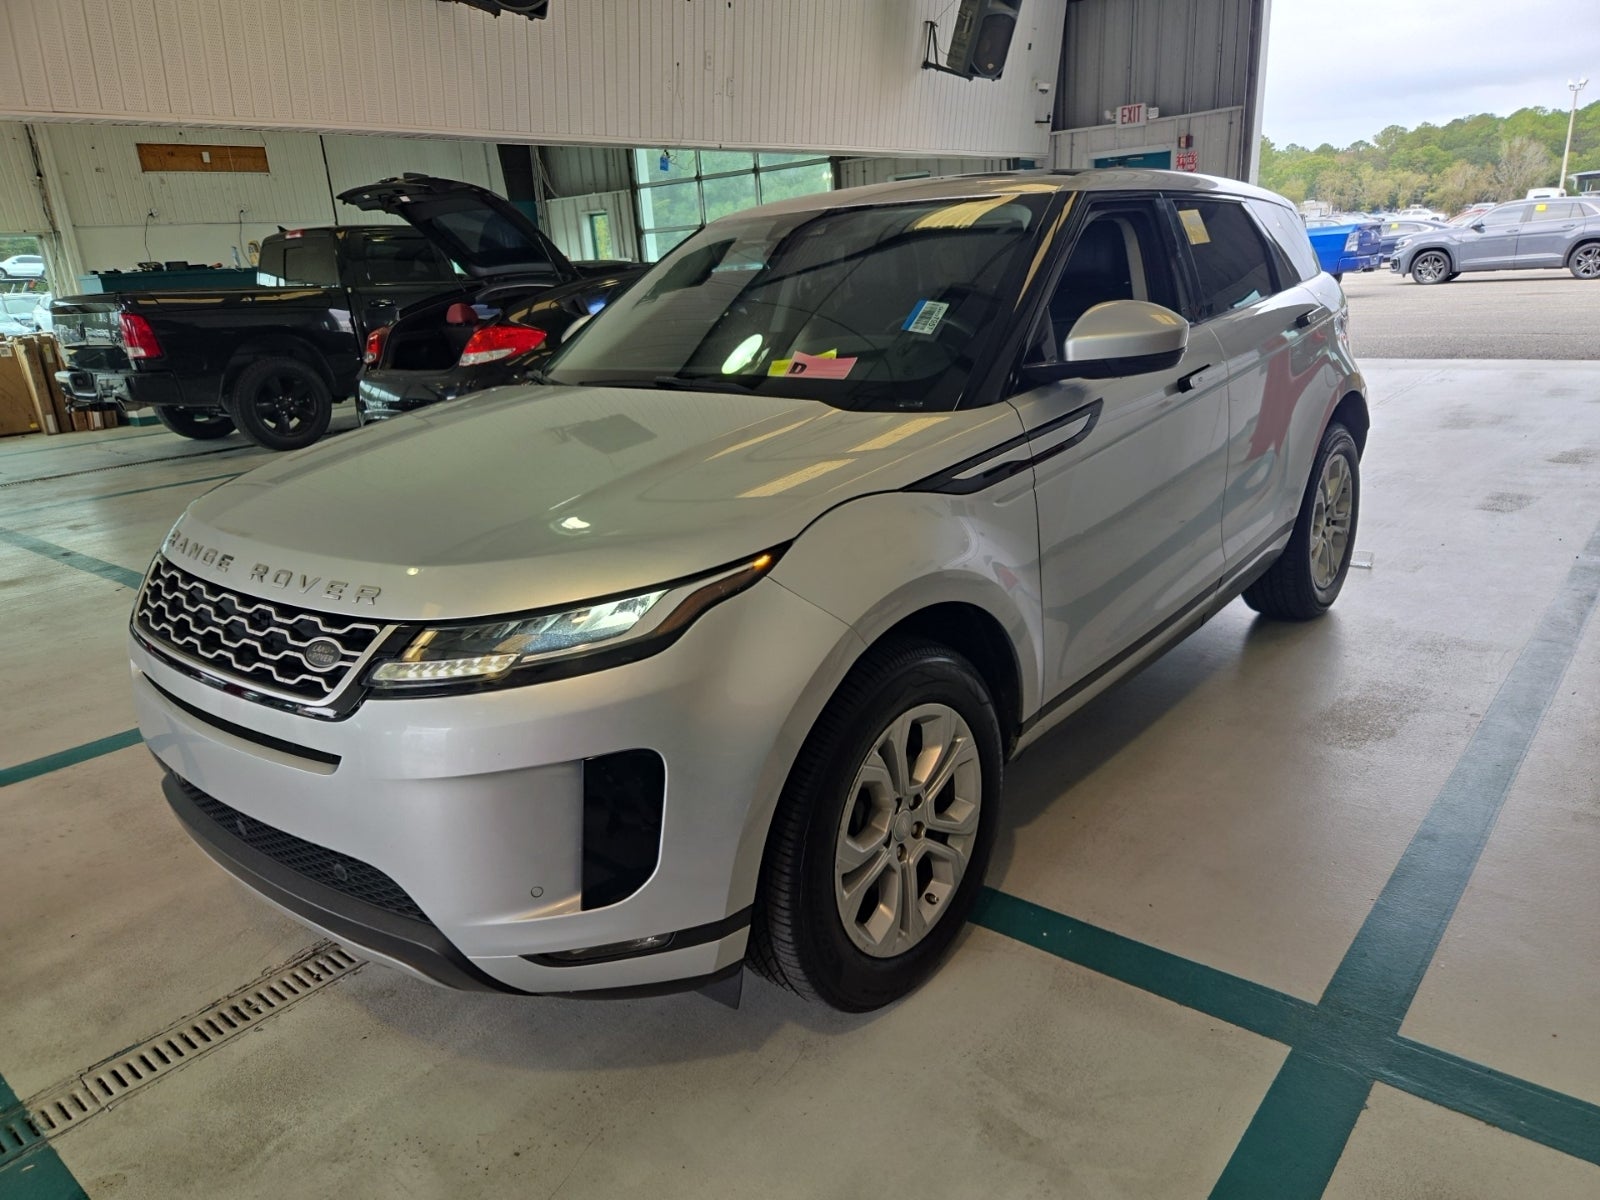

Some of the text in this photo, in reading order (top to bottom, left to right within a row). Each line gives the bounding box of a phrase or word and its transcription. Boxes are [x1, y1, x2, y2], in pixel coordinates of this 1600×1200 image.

[1121, 105, 1142, 125] EXIT
[789, 362, 807, 374] D
[169, 530, 382, 606] RANGE ROVER
